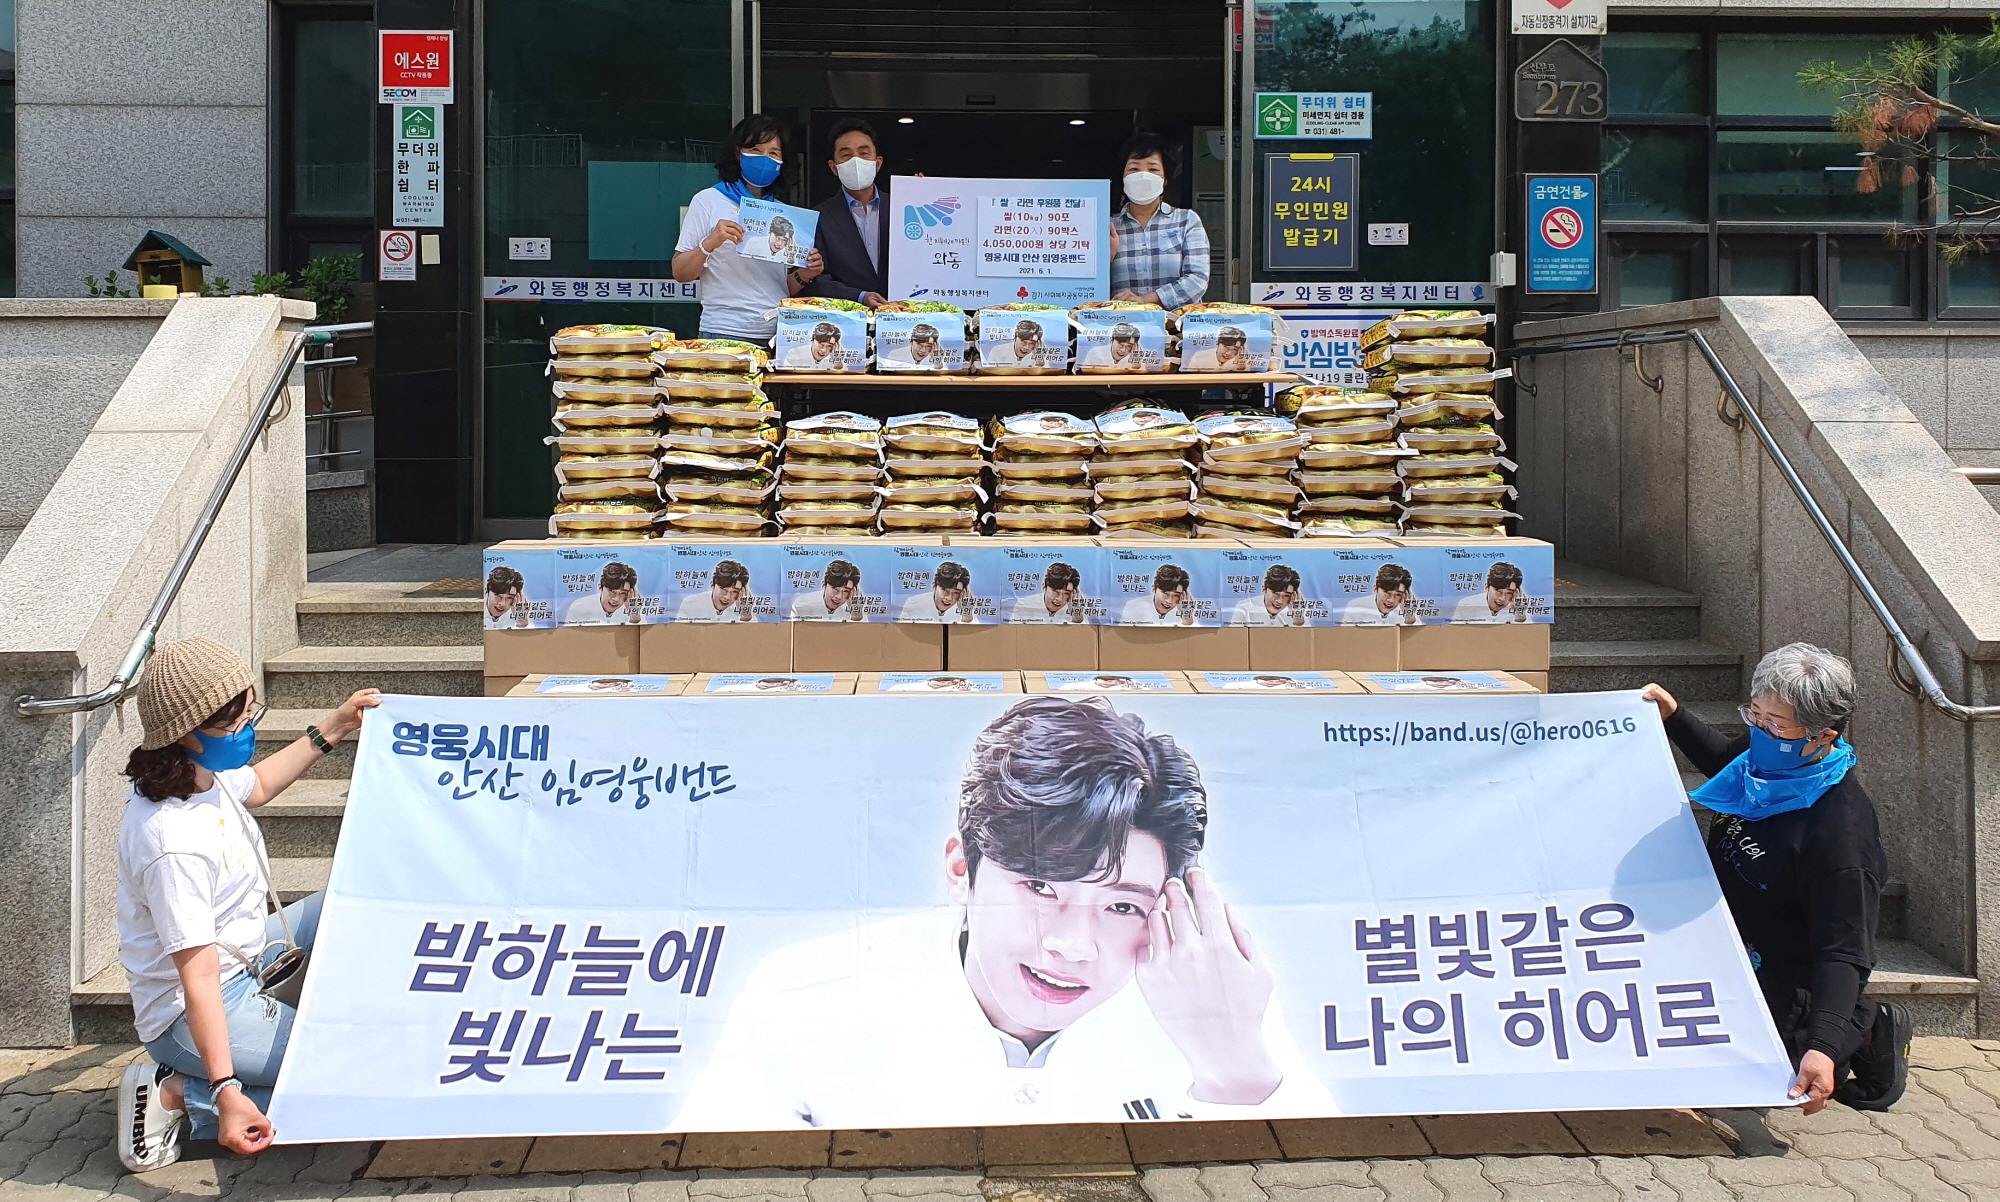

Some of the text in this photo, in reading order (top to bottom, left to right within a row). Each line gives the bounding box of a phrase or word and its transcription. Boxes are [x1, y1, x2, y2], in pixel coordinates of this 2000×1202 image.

[1522, 15, 1598, 29] 자동심장충격기 설치기관
[394, 52, 439, 70] 에스원
[383, 89, 416, 97] SECOM
[1536, 81, 1603, 115] 273
[1302, 96, 1365, 109] 무더위 쉼터
[1350, 112, 1365, 120] 겸용
[397, 142, 439, 157] 무더위
[1290, 176, 1331, 193] 24시
[1534, 185, 1583, 200] 금연건물
[1000, 198, 1009, 208] 쌀
[1017, 198, 1034, 208] 라면
[1274, 202, 1348, 220] 무인민원
[1004, 212, 1070, 222] 쌀(10kg) 90포
[1048, 226, 1079, 236] 90박스
[1283, 228, 1338, 246] 발급기
[982, 239, 1090, 250] 4,050,000원 상당 기탁
[932, 252, 962, 269] 와동
[984, 252, 1086, 264] 영웅시대 안산 임영웅밴드
[529, 280, 697, 298] 와동행정복지센터
[933, 289, 989, 297] 와동행정복지센터
[1295, 284, 1459, 301] 와동행정복지센터
[1310, 329, 1359, 338] 방역소독완료
[1283, 342, 1362, 368] 안심방
[1323, 716, 1637, 746] https://band.us/@hero0616
[392, 722, 550, 762] 영웅시대
[437, 756, 737, 809] 안산 임영웅밴드
[1355, 903, 1646, 984] 별빛같은
[409, 921, 725, 997] 밤하늘에
[1324, 982, 1732, 1066] 나의 히어로
[439, 1010, 683, 1084] 빛나는
